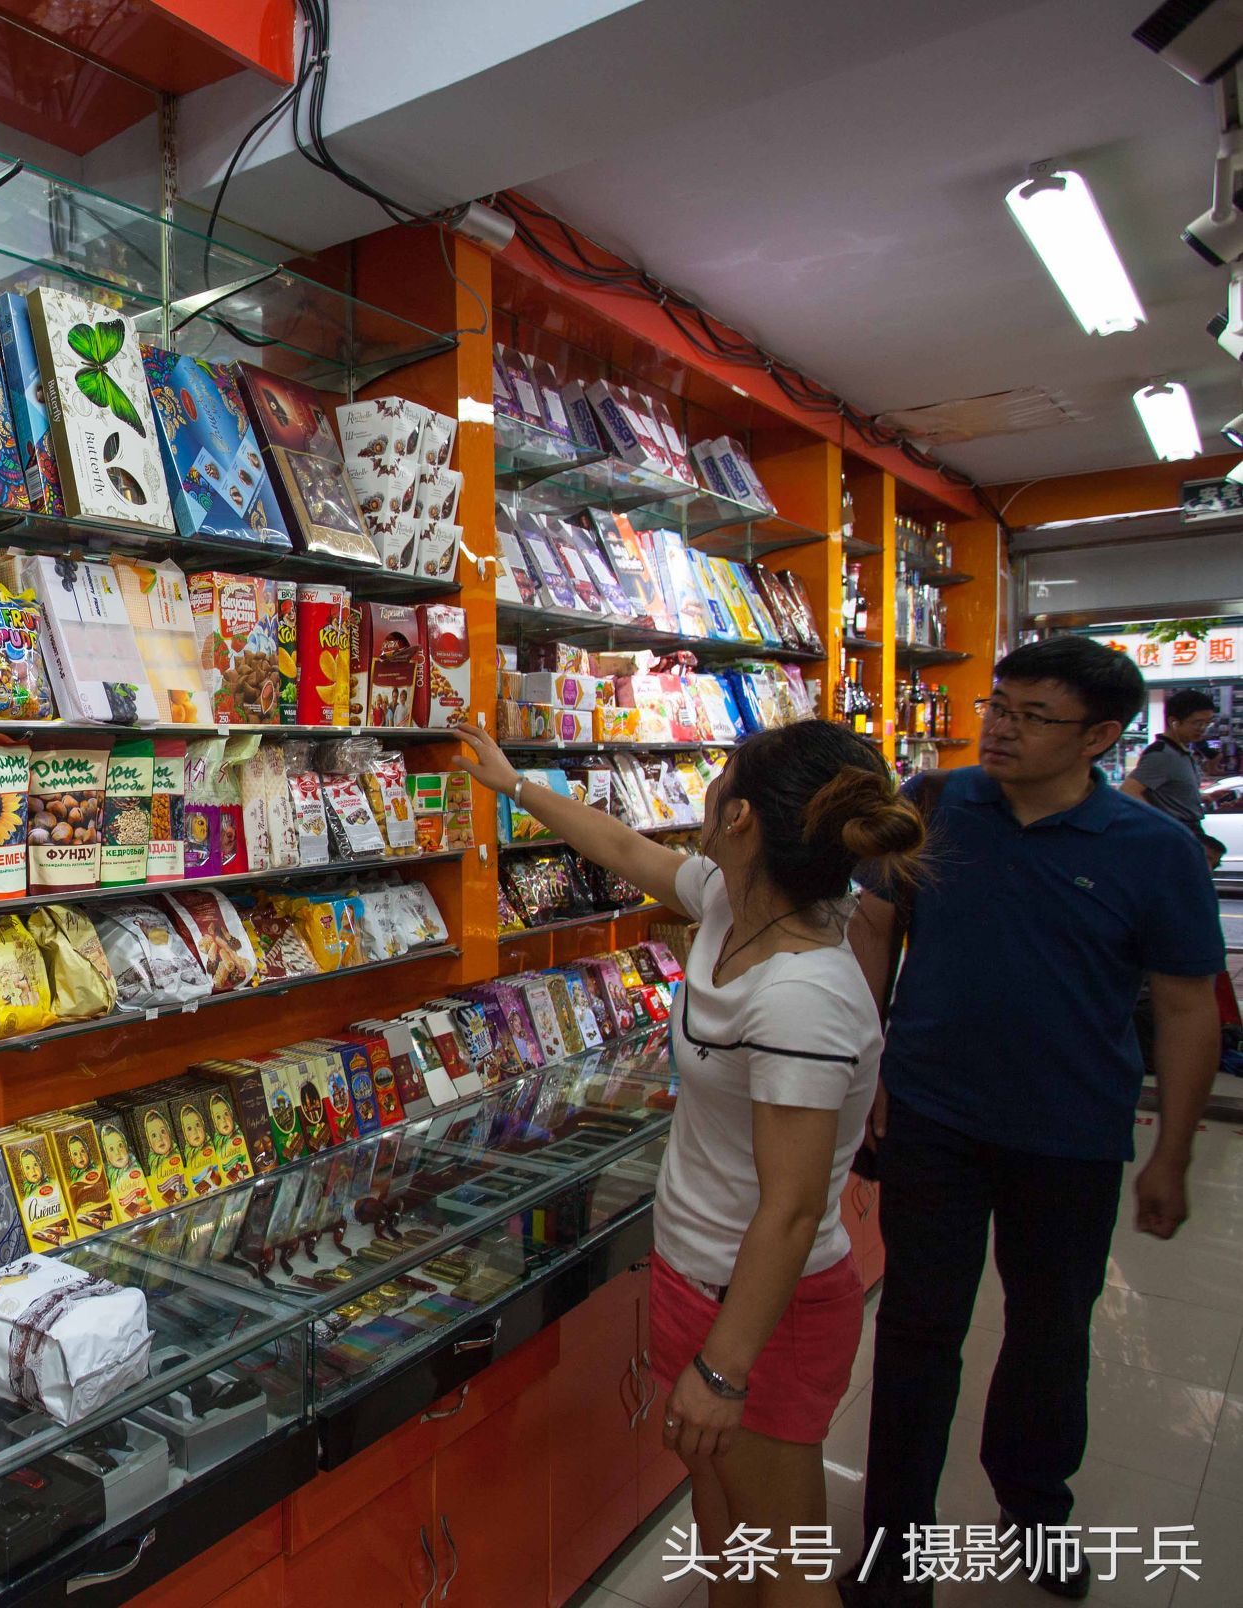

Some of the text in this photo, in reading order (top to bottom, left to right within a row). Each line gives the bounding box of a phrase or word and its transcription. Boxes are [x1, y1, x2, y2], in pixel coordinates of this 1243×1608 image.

[48, 379, 61, 423] Butterfly
[84, 431, 105, 497] Butterfly
[1137, 638, 1235, 666] 俄罗斯
[31, 758, 95, 778] Дары
[46, 847, 96, 861] ФУНДУ
[106, 847, 145, 857] КЕДРОВЫЙ
[28, 1196, 62, 1223] Алёнка
